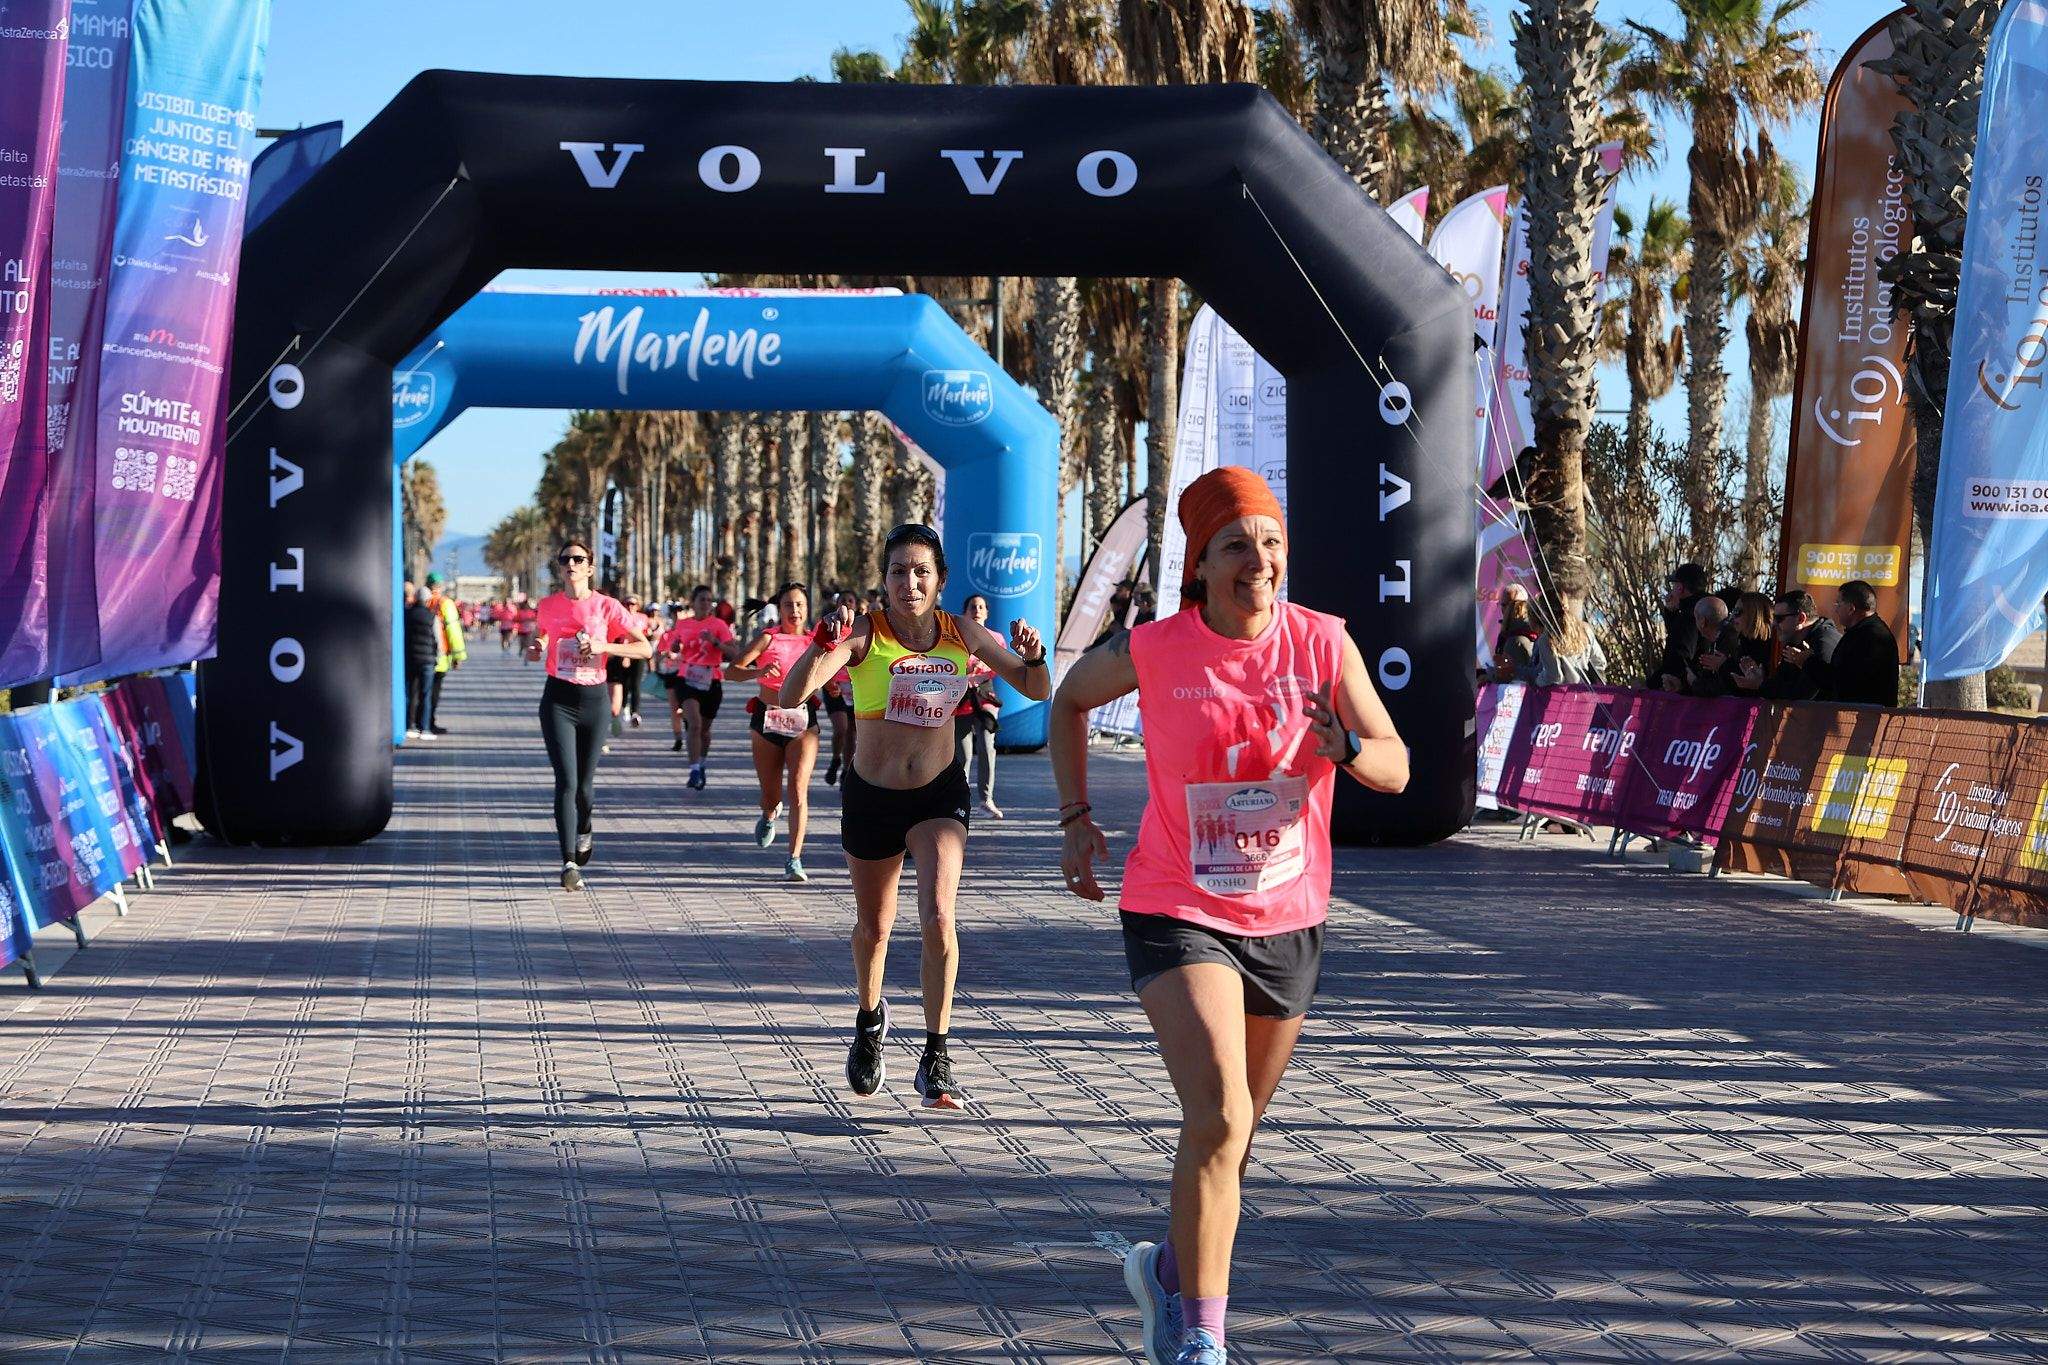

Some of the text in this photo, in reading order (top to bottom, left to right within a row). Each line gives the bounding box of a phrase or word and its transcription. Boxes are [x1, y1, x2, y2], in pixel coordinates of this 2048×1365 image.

[72, 13, 128, 38] MAMA
[149, 117, 238, 150] JUNTOS EL
[192, 147, 213, 170] DE
[560, 142, 1138, 197] VOLVO
[2006, 175, 2043, 305] Institutos
[1839, 217, 1870, 343] Institutos
[0, 290, 29, 314] TO
[573, 305, 782, 396] Marlene
[120, 390, 192, 423] SÚMATE
[118, 416, 201, 446] MOVIMIENTO
[1971, 484, 2000, 499] 900
[2005, 485, 2026, 499] 131
[1379, 381, 1412, 690] OLVO
[269, 363, 305, 781] VOLVO
[896, 662, 954, 675] Serrano
[1172, 686, 1224, 699] OYSHO
[914, 705, 944, 719] 016
[1582, 715, 1636, 770] renfe
[1663, 726, 1721, 784] renfe
[1234, 829, 1281, 850] 016
[1206, 878, 1246, 888] OYSHO
